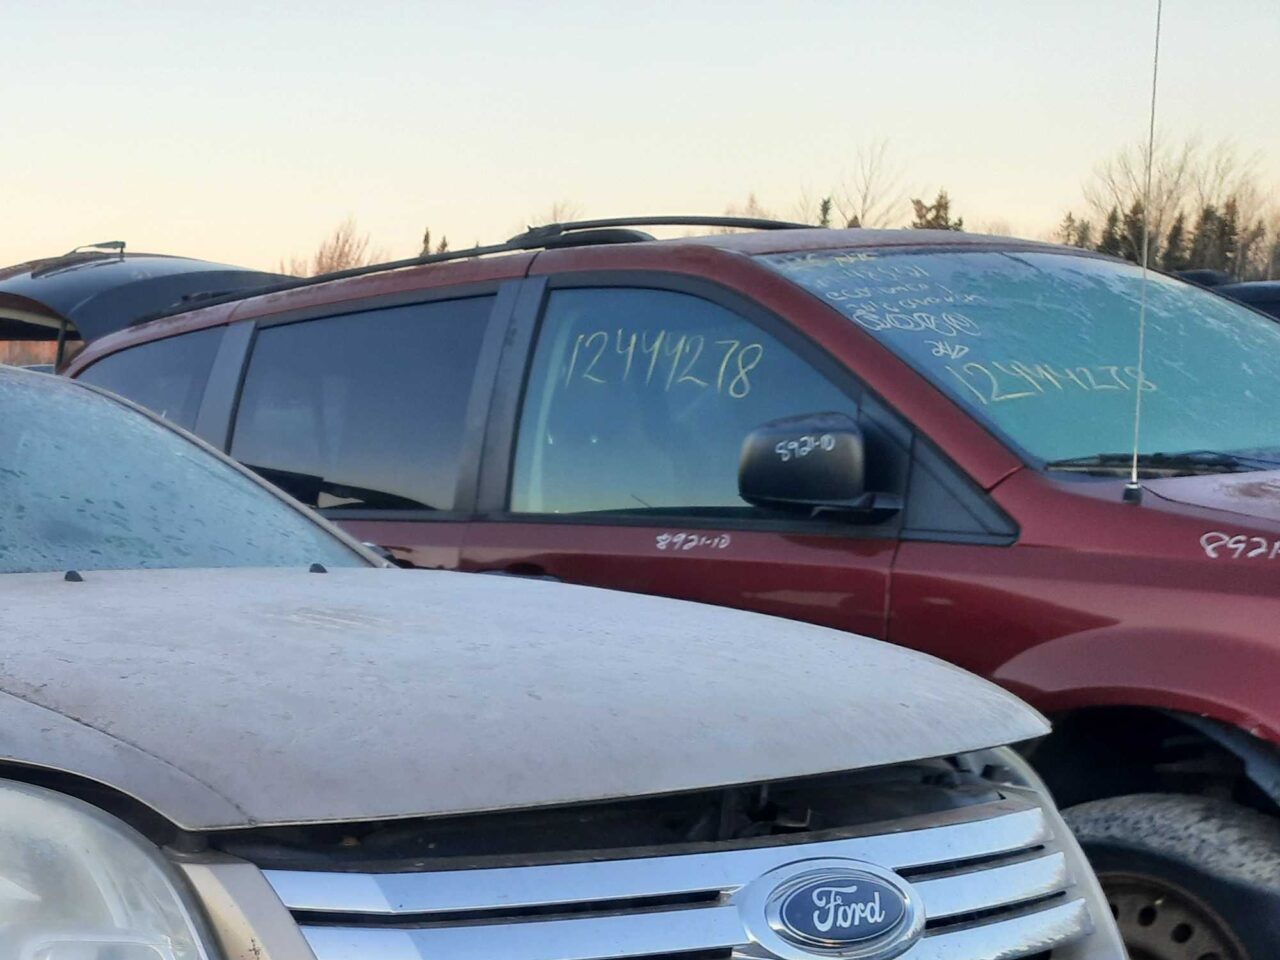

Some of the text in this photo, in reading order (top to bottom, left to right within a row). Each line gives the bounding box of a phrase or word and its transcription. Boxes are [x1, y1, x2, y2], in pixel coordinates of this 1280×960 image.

[565, 328, 764, 399] 12444278
[775, 434, 836, 462] 8921-10
[656, 532, 731, 550] 8921-10
[812, 885, 886, 932] Ford
